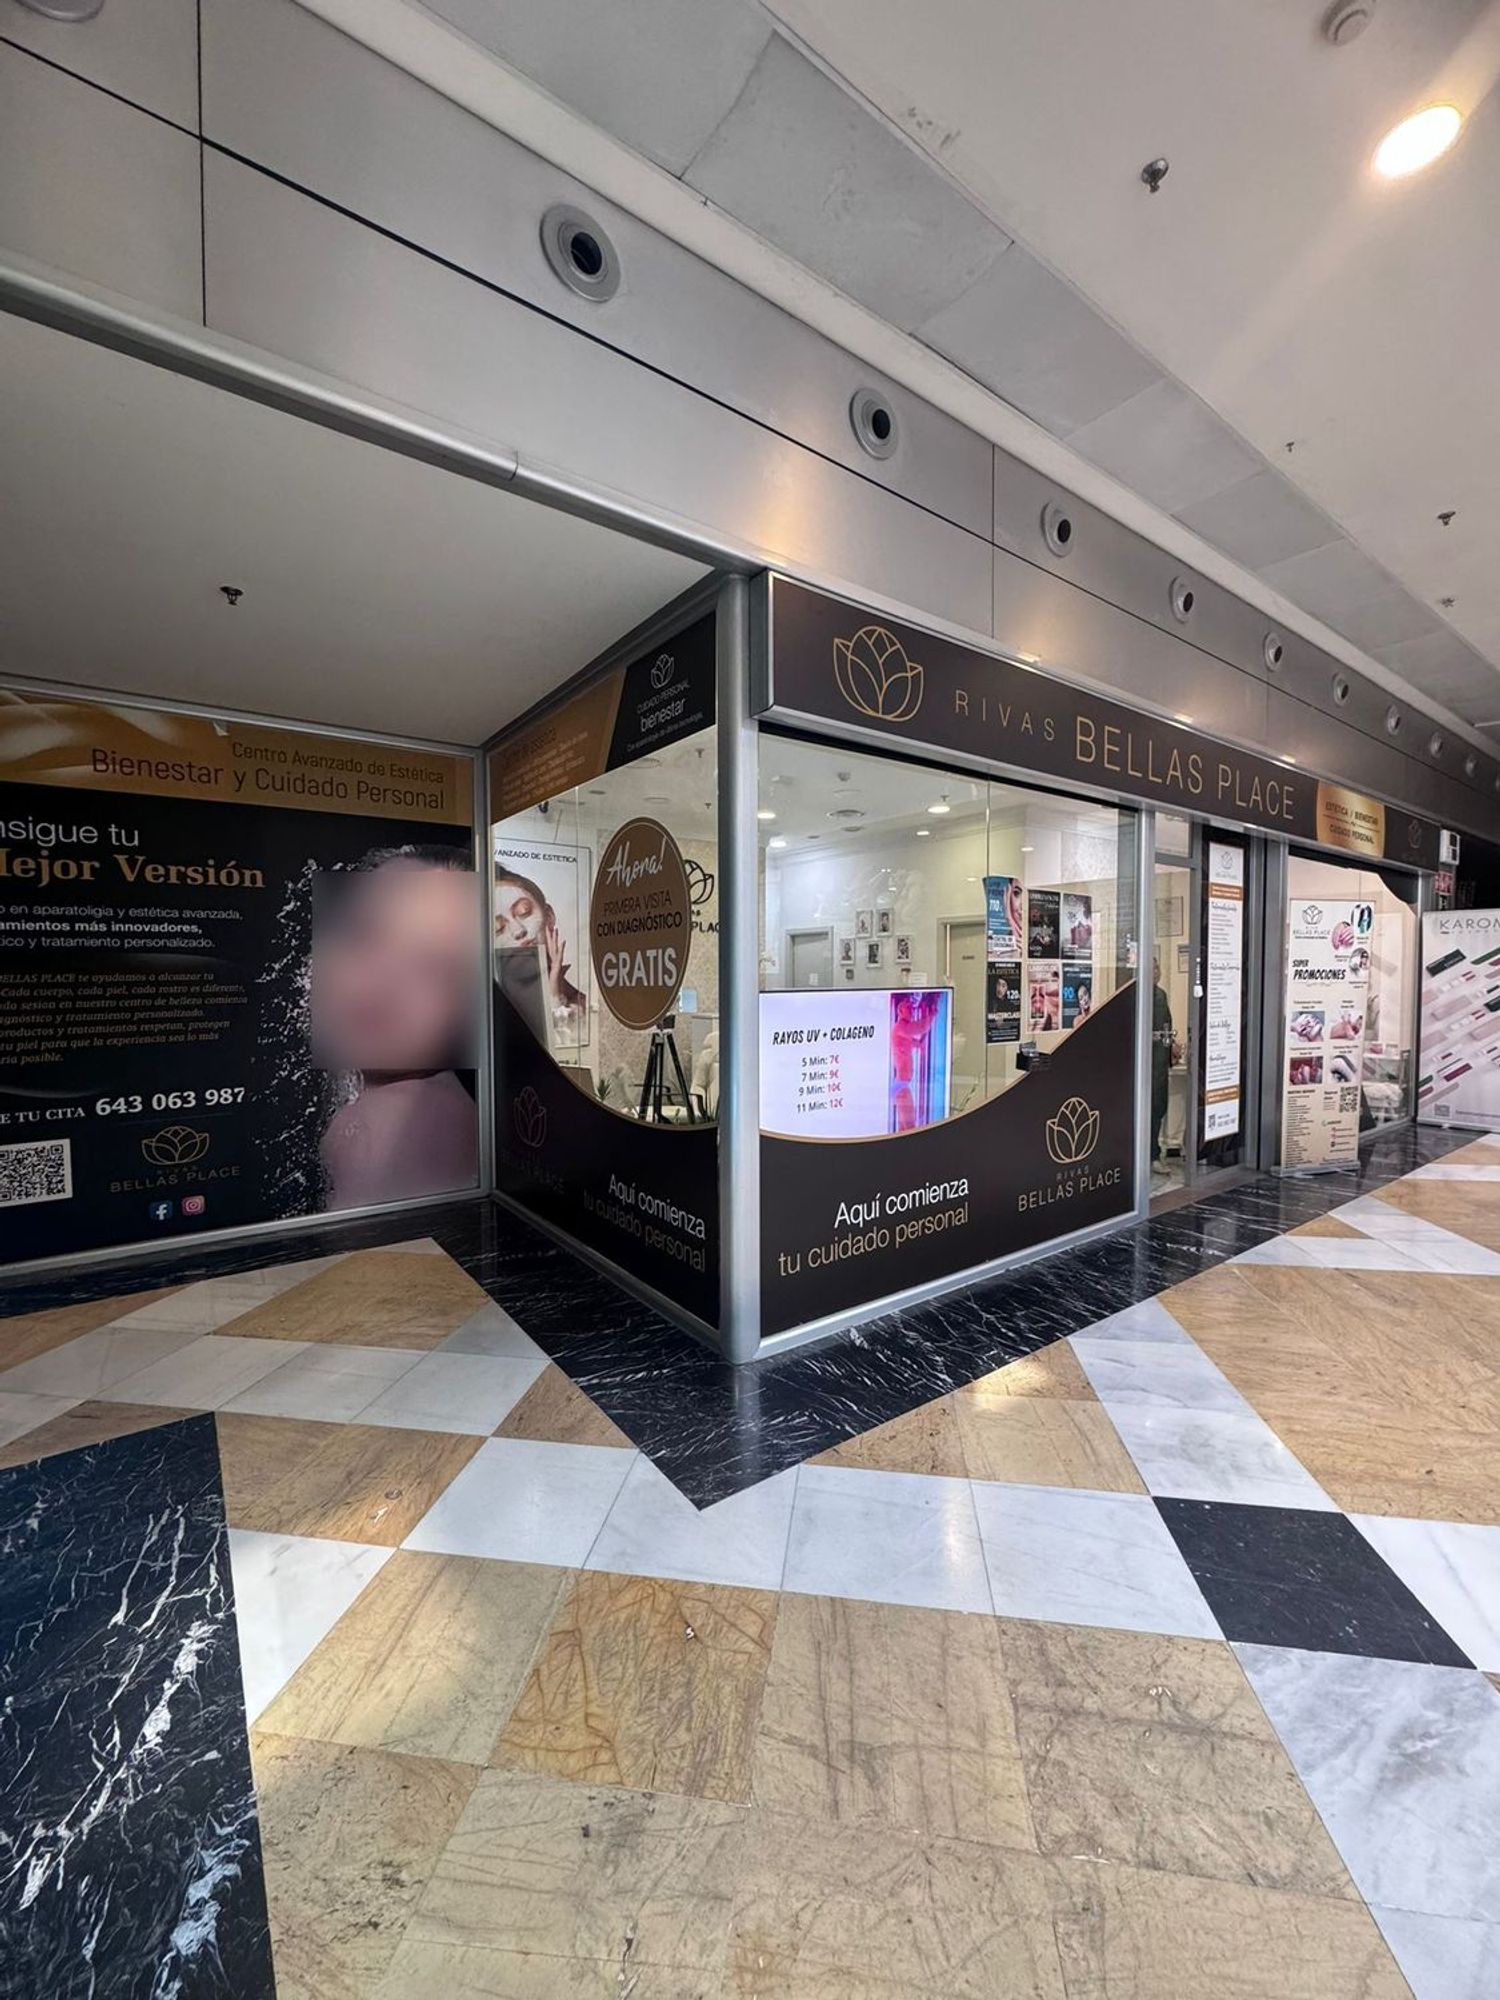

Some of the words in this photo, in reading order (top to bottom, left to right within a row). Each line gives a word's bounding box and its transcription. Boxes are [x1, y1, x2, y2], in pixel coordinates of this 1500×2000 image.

[640, 698, 686, 732] bienestar
[232, 742, 286, 765] Centro
[291, 746, 363, 774] Avanzado
[368, 760, 386, 776] de
[390, 763, 445, 784] Estética
[954, 689, 1056, 742] RIVAS
[1076, 715, 1202, 795] BELLAS
[1218, 763, 1295, 820] PLACE
[92, 748, 224, 785] Bienestar
[233, 770, 247, 793] y
[255, 768, 349, 799] Cuidado
[357, 780, 445, 810] Personal
[108, 823, 139, 846] tu
[113, 853, 267, 888] Versión
[605, 836, 666, 888] Ahora!
[9, 904, 29, 915] en
[116, 907, 126, 919] y
[128, 907, 179, 918] estética
[182, 908, 243, 920] avanzada,
[603, 896, 641, 918] PRIMERA
[642, 889, 672, 911] VISITA
[74, 920, 107, 932] más
[111, 920, 203, 935] innovadores,
[597, 919, 616, 938] CON
[617, 910, 683, 934] DIAGNÓSTICO
[28, 938, 38, 949] y
[41, 936, 121, 947] tratamiento
[124, 937, 216, 949] personalizado.
[41, 973, 77, 983] PLACE
[78, 974, 90, 983] te
[158, 972, 202, 981] alcanzar
[601, 947, 678, 988] GRATIS
[1293, 969, 1346, 980] PROMOCIONES
[0, 986, 31, 998] Cada
[77, 986, 104, 996] cada
[158, 986, 188, 994] rostro
[154, 997, 168, 1006] de
[65, 1012, 131, 1022] tratamiento
[67, 1023, 138, 1034] tratamientos
[41, 1040, 68, 1051] para
[772, 1030, 804, 1046] RAYOS
[806, 1028, 821, 1043] UV
[829, 1024, 876, 1042] COLAGENO
[801, 1056, 808, 1068] 5
[809, 1056, 828, 1067] Min:
[829, 1054, 841, 1065] 7€
[801, 1072, 807, 1082] 7
[809, 1071, 828, 1082] Min:
[829, 1069, 840, 1080] 9€
[798, 1087, 805, 1097] 9
[806, 1084, 826, 1096] Min:
[827, 1082, 842, 1094] 10€
[15, 1110, 41, 1123] TU
[45, 1106, 86, 1120] CITA
[95, 1094, 143, 1117] 643
[151, 1090, 197, 1111] 063
[205, 1086, 246, 1107] 987
[796, 1103, 806, 1114] 11
[808, 1101, 828, 1113] Min:
[829, 1098, 844, 1110] 12€
[109, 1174, 179, 1194] BELLAS
[186, 1165, 241, 1181] PLACE
[1018, 1181, 1075, 1213] BELLAS
[1080, 1167, 1121, 1193] PLACE
[833, 1193, 882, 1229] Aquí
[885, 1175, 969, 1216] comienza
[638, 1191, 706, 1240] comienza
[583, 1187, 595, 1210] tu
[596, 1199, 641, 1238] cuidado
[645, 1224, 706, 1275] personal
[778, 1250, 801, 1277] tu
[808, 1223, 890, 1270] cuidado
[895, 1201, 969, 1249] personal
